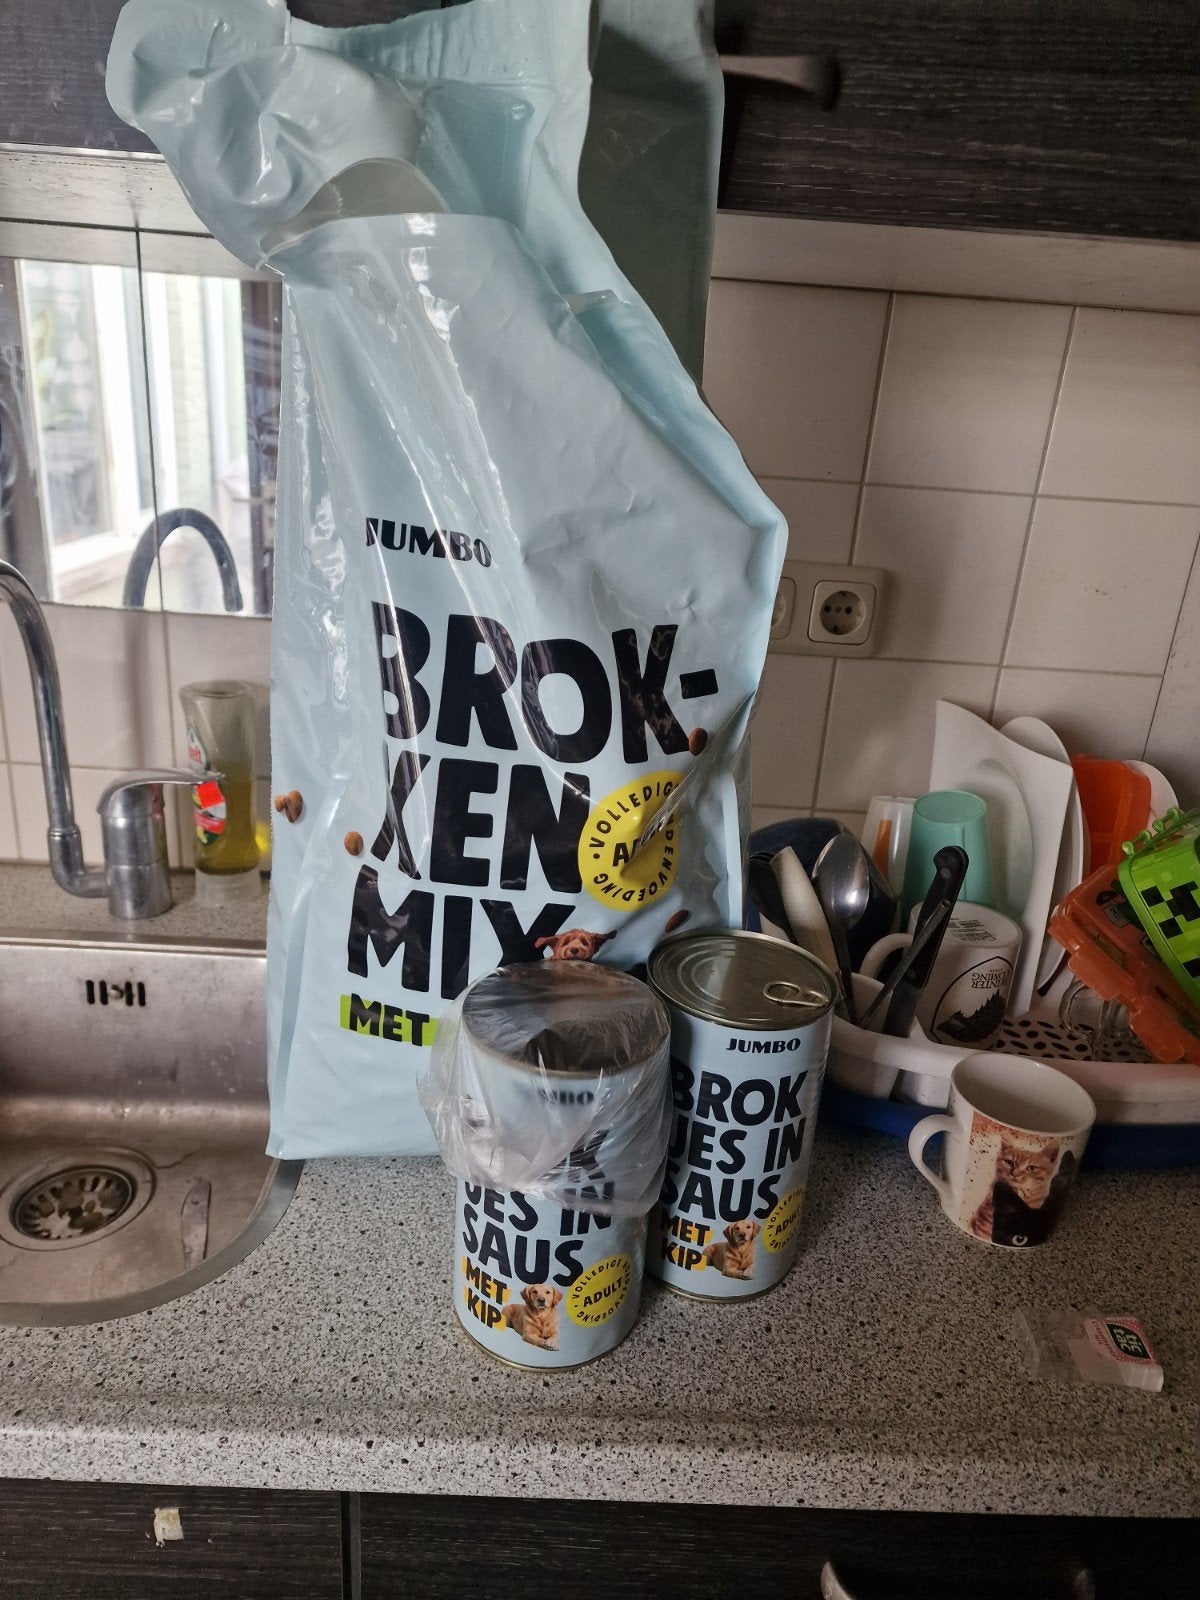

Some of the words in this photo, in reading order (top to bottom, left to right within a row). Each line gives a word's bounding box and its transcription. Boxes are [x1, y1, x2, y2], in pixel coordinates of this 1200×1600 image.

[366, 517, 492, 568] JUMBO
[371, 600, 718, 764] BROK-
[589, 781, 680, 848] VOLLEDIG
[347, 864, 576, 1001] MIX
[350, 993, 429, 1047] MET
[726, 1037, 801, 1053] JUMBO
[670, 1056, 809, 1126] BROK
[763, 1117, 807, 1174] IN
[660, 1159, 782, 1222] SAUS
[462, 1203, 584, 1287] SAUS
[661, 1208, 711, 1247] MET
[661, 1236, 703, 1270] KIP
[466, 1256, 508, 1306] MET
[583, 1277, 623, 1308] ADULT
[467, 1288, 502, 1329] KIP
[1113, 1328, 1132, 1351] tac
[1125, 1334, 1143, 1353] tic
